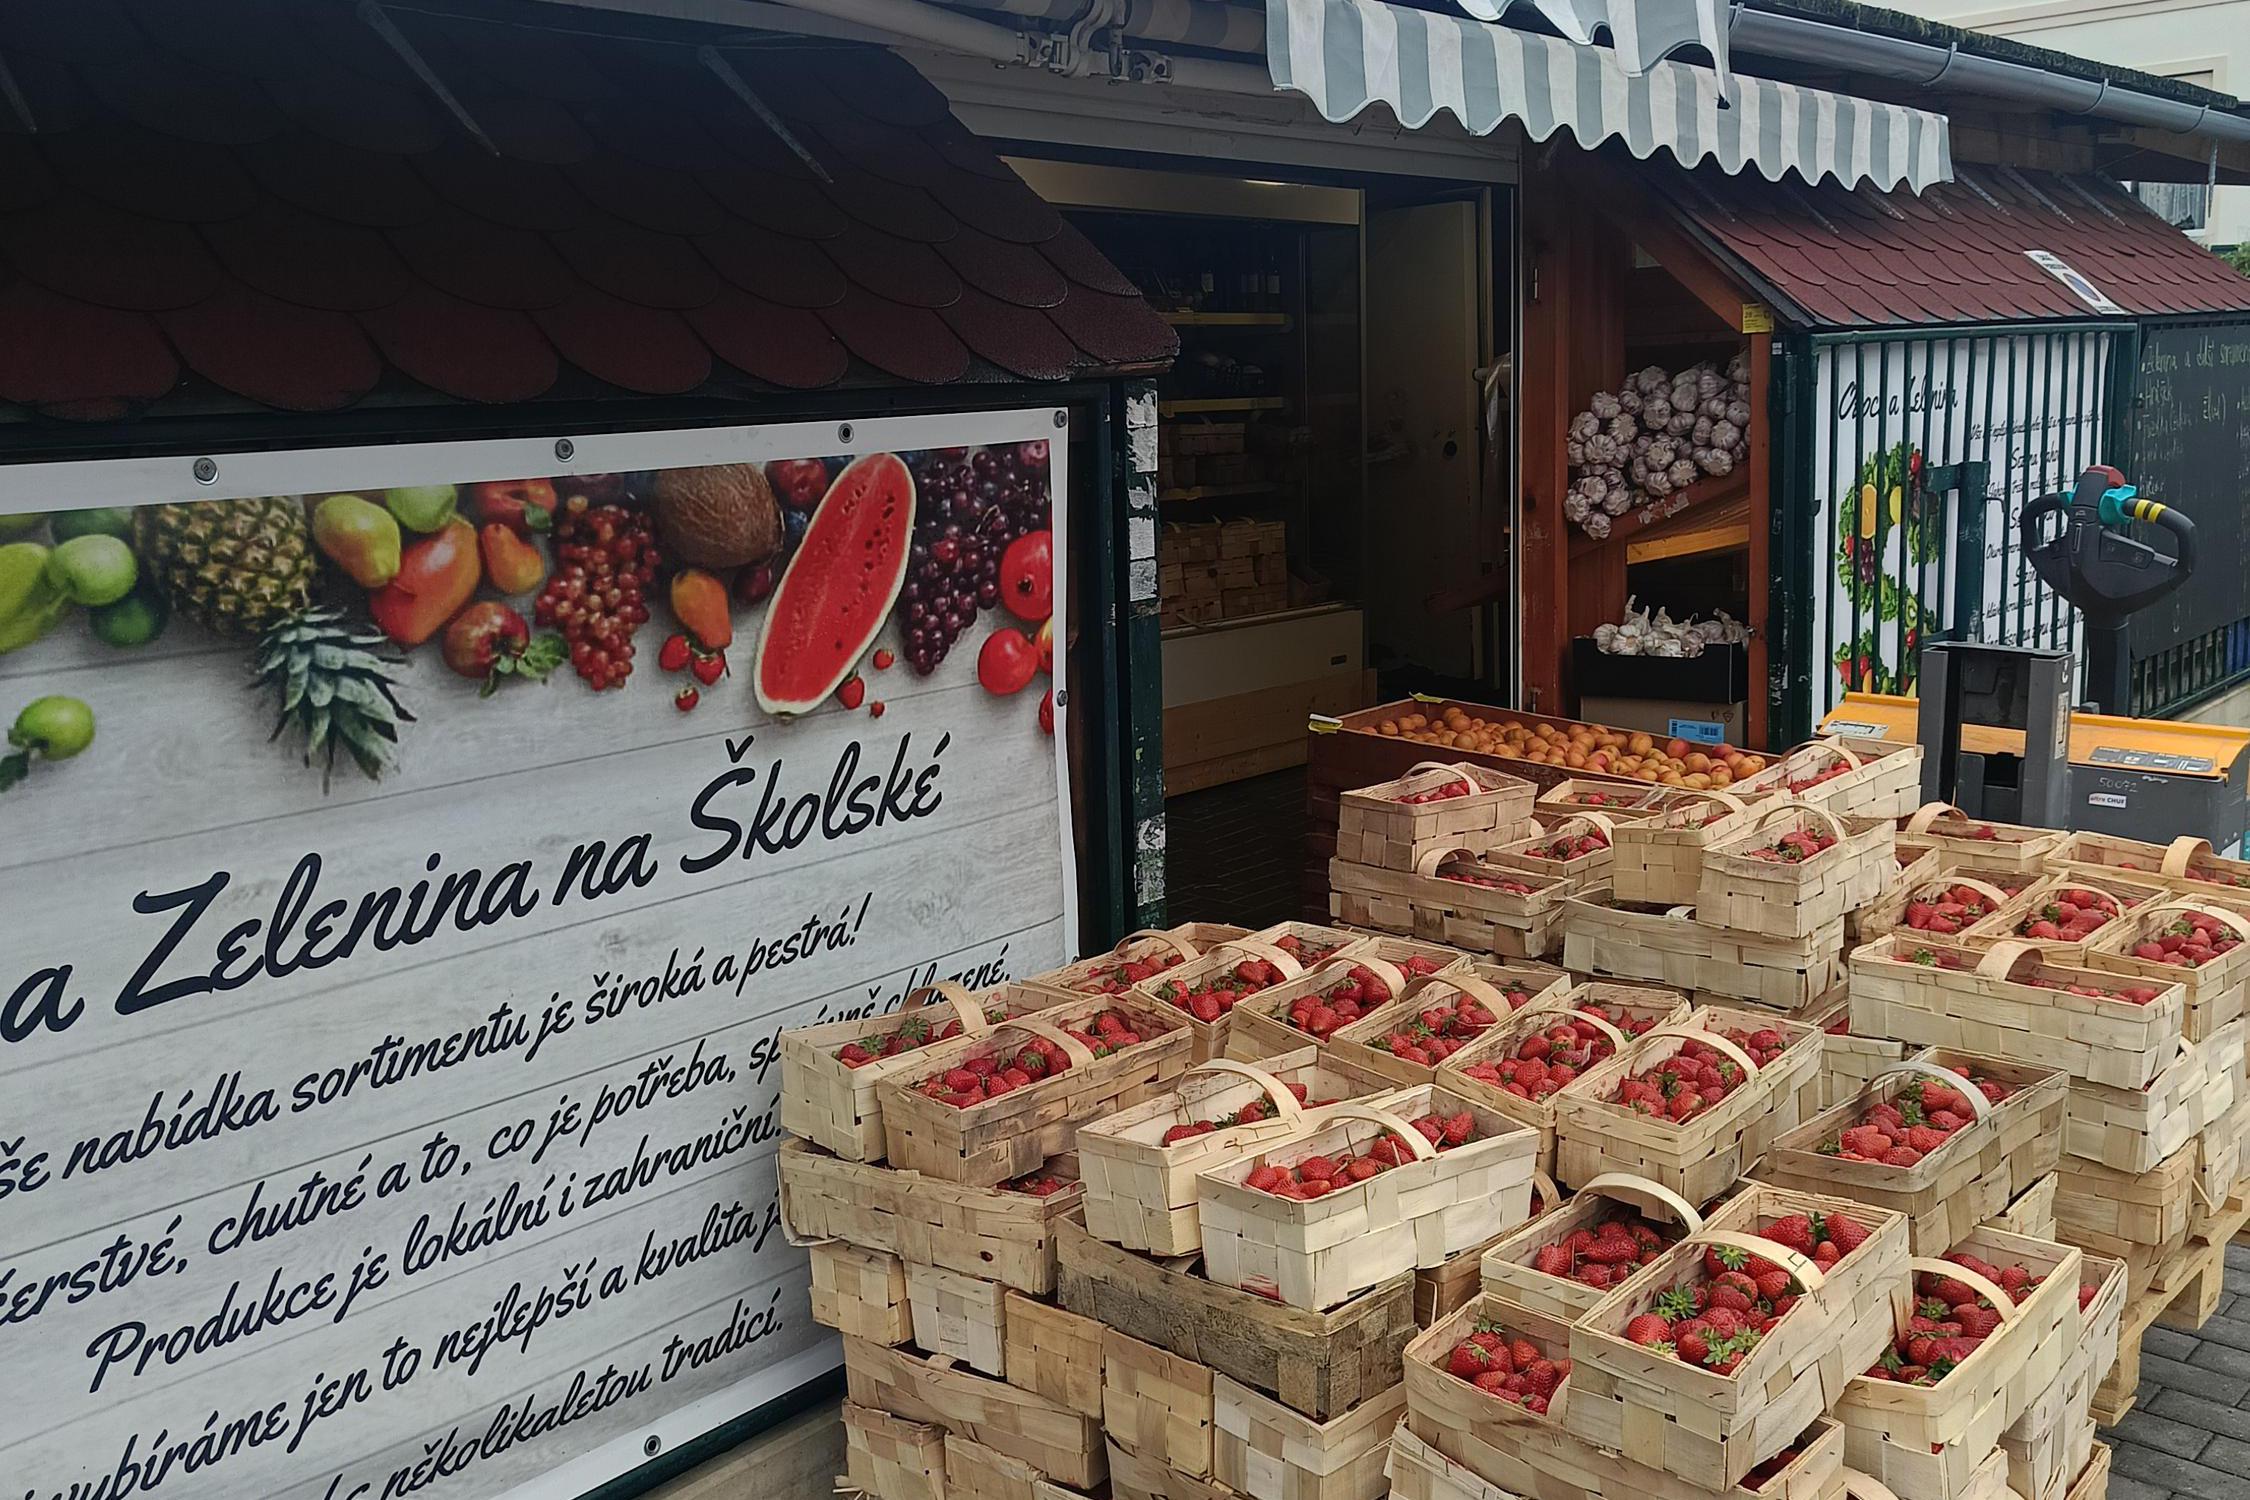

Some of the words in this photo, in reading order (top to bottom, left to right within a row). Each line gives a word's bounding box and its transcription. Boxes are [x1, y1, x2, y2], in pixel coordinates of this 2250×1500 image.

[1839, 381, 1881, 420] Ooc
[1888, 394, 1900, 416] a
[0, 965, 84, 1042] a
[115, 853, 539, 1015] Zelenina
[552, 834, 658, 905] na
[680, 731, 950, 873] Školské
[62, 1071, 280, 1179] nabídka
[292, 1002, 529, 1112] sortimentu
[525, 992, 574, 1062] je
[585, 947, 705, 1024] široká
[713, 955, 738, 985] a
[736, 892, 872, 997] pestrá!
[209, 1153, 372, 1254] chutné
[377, 1162, 410, 1198] a
[421, 1132, 471, 1183] to,
[488, 1119, 535, 1159] co
[532, 1095, 581, 1164] je
[580, 1038, 735, 1147] potřeba,
[86, 1267, 337, 1393] Produkce
[334, 1254, 389, 1323] je
[403, 1174, 555, 1275] lokální
[559, 1173, 576, 1217] i
[583, 1092, 781, 1208] zahraniční.
[287, 1369, 372, 1453] jen
[383, 1336, 421, 1390] to
[433, 1257, 597, 1376] nejlepší
[600, 1265, 627, 1299] a
[634, 1201, 758, 1285] kvalita
[752, 1190, 781, 1254] j
[381, 1364, 652, 1500] několikaletou
[661, 1287, 781, 1382] tradicí.
